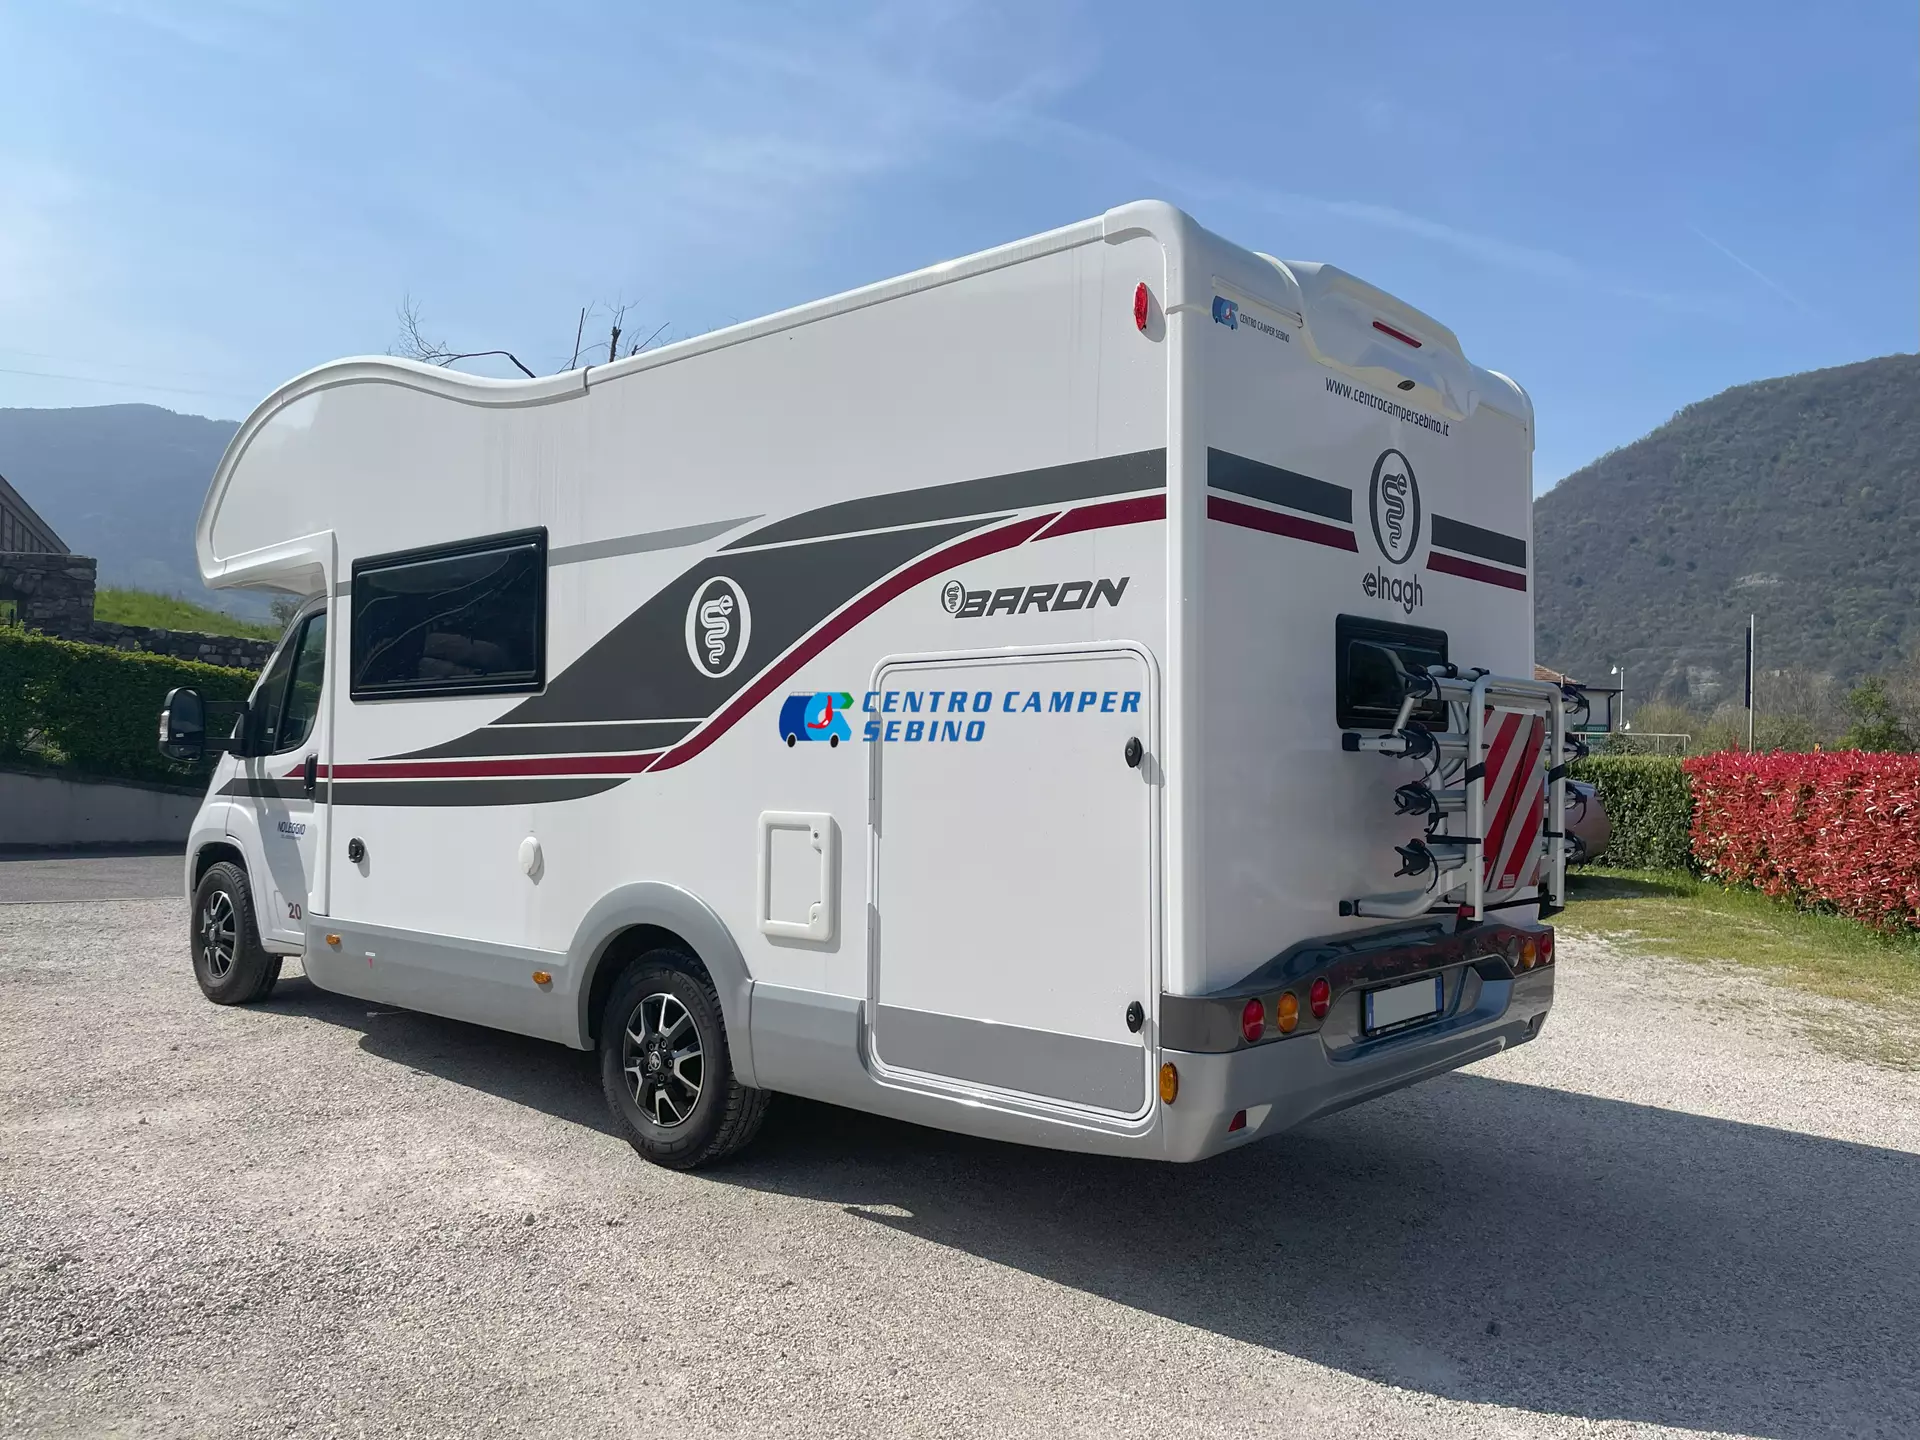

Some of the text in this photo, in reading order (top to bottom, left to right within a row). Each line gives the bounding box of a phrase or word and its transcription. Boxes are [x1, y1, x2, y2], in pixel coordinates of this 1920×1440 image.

[1239, 313, 1290, 343] CENTRO CAMPER SEBINO
[1325, 376, 1449, 437] www.centrocampersebino.it
[954, 576, 1131, 619] BARON
[1362, 565, 1423, 615] elnagh
[277, 821, 306, 836] NOLEGGIO
